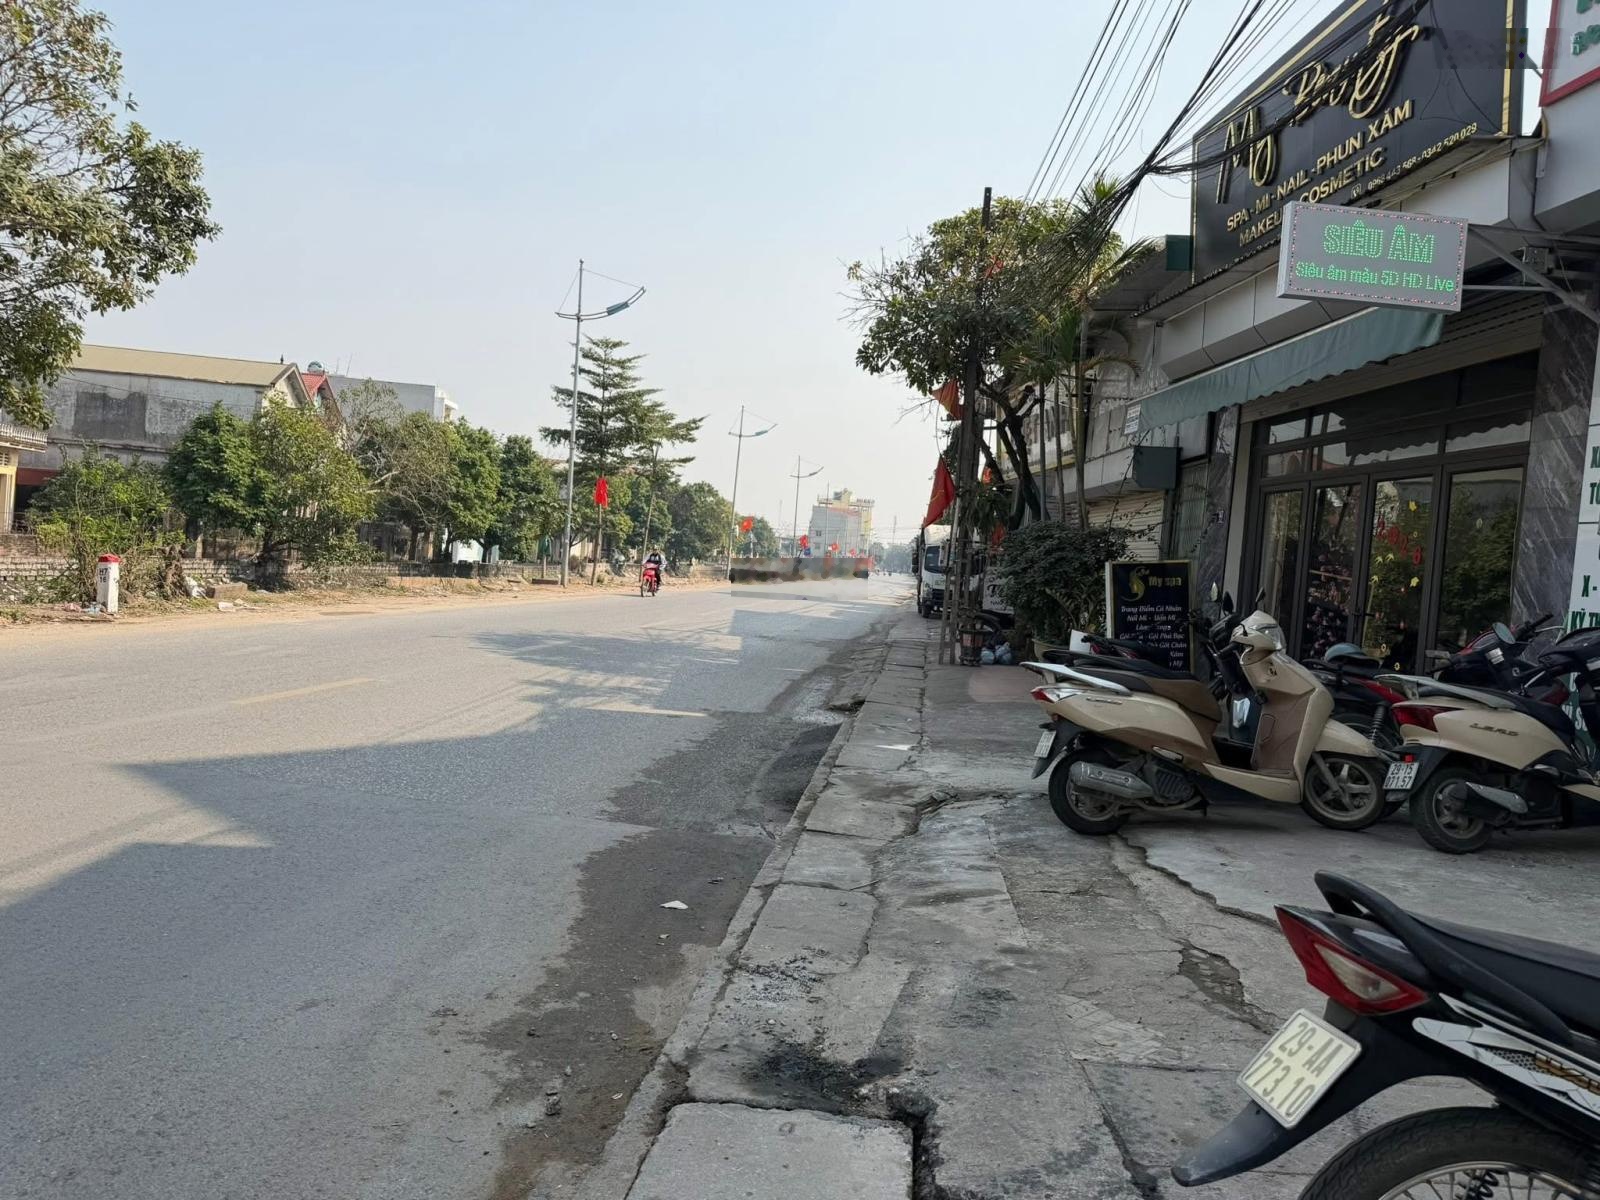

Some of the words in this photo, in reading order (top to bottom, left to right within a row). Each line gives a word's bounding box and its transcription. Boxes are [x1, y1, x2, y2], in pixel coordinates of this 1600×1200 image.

[1226, 208, 1251, 232] SPA
[1277, 171, 1311, 201] NAIL
[1316, 131, 1361, 175] PHUN
[1367, 99, 1412, 142] XĂM
[1300, 146, 1383, 205] COSMETIC
[1323, 219, 1384, 259] SIÊU
[1387, 224, 1435, 264] ÂM
[1295, 261, 1324, 280] Siêu
[1327, 264, 1348, 282] âm
[1349, 268, 1378, 285] màu
[1380, 270, 1400, 287] 5D
[1401, 272, 1423, 289] HD
[1425, 275, 1454, 292] Live
[1278, 1021, 1343, 1078] 29-AA
[1244, 1050, 1316, 1118] 773.10
